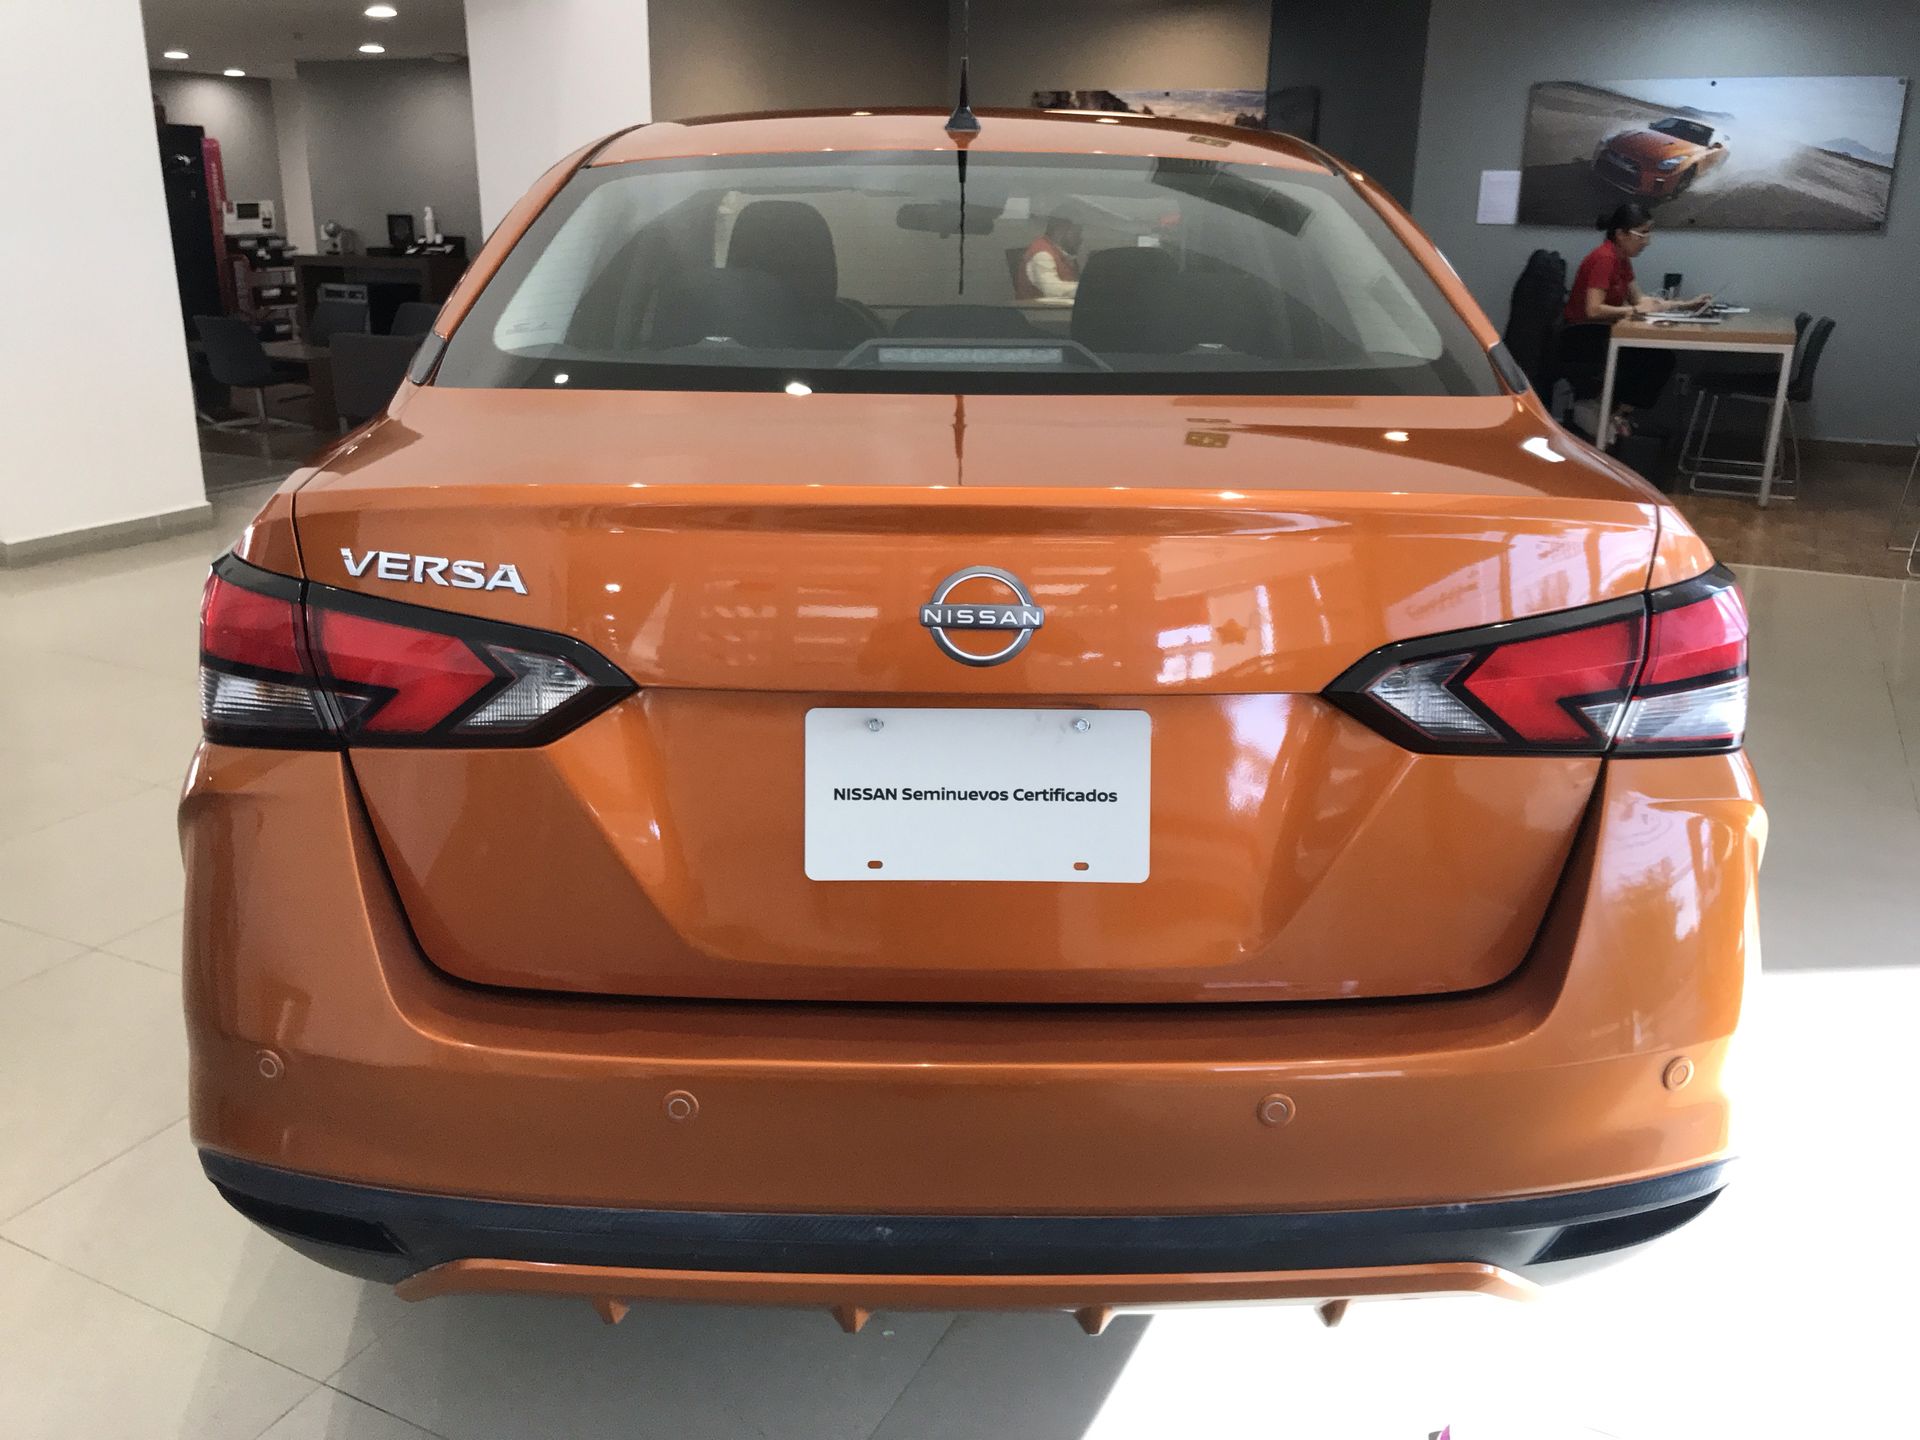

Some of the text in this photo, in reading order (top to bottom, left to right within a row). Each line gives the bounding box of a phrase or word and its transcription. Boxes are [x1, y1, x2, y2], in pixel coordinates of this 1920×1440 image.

[340, 548, 528, 595] VERSA
[924, 609, 1040, 625] NISSAN
[833, 787, 1118, 802] NISSAN Seminuevos Certificados
